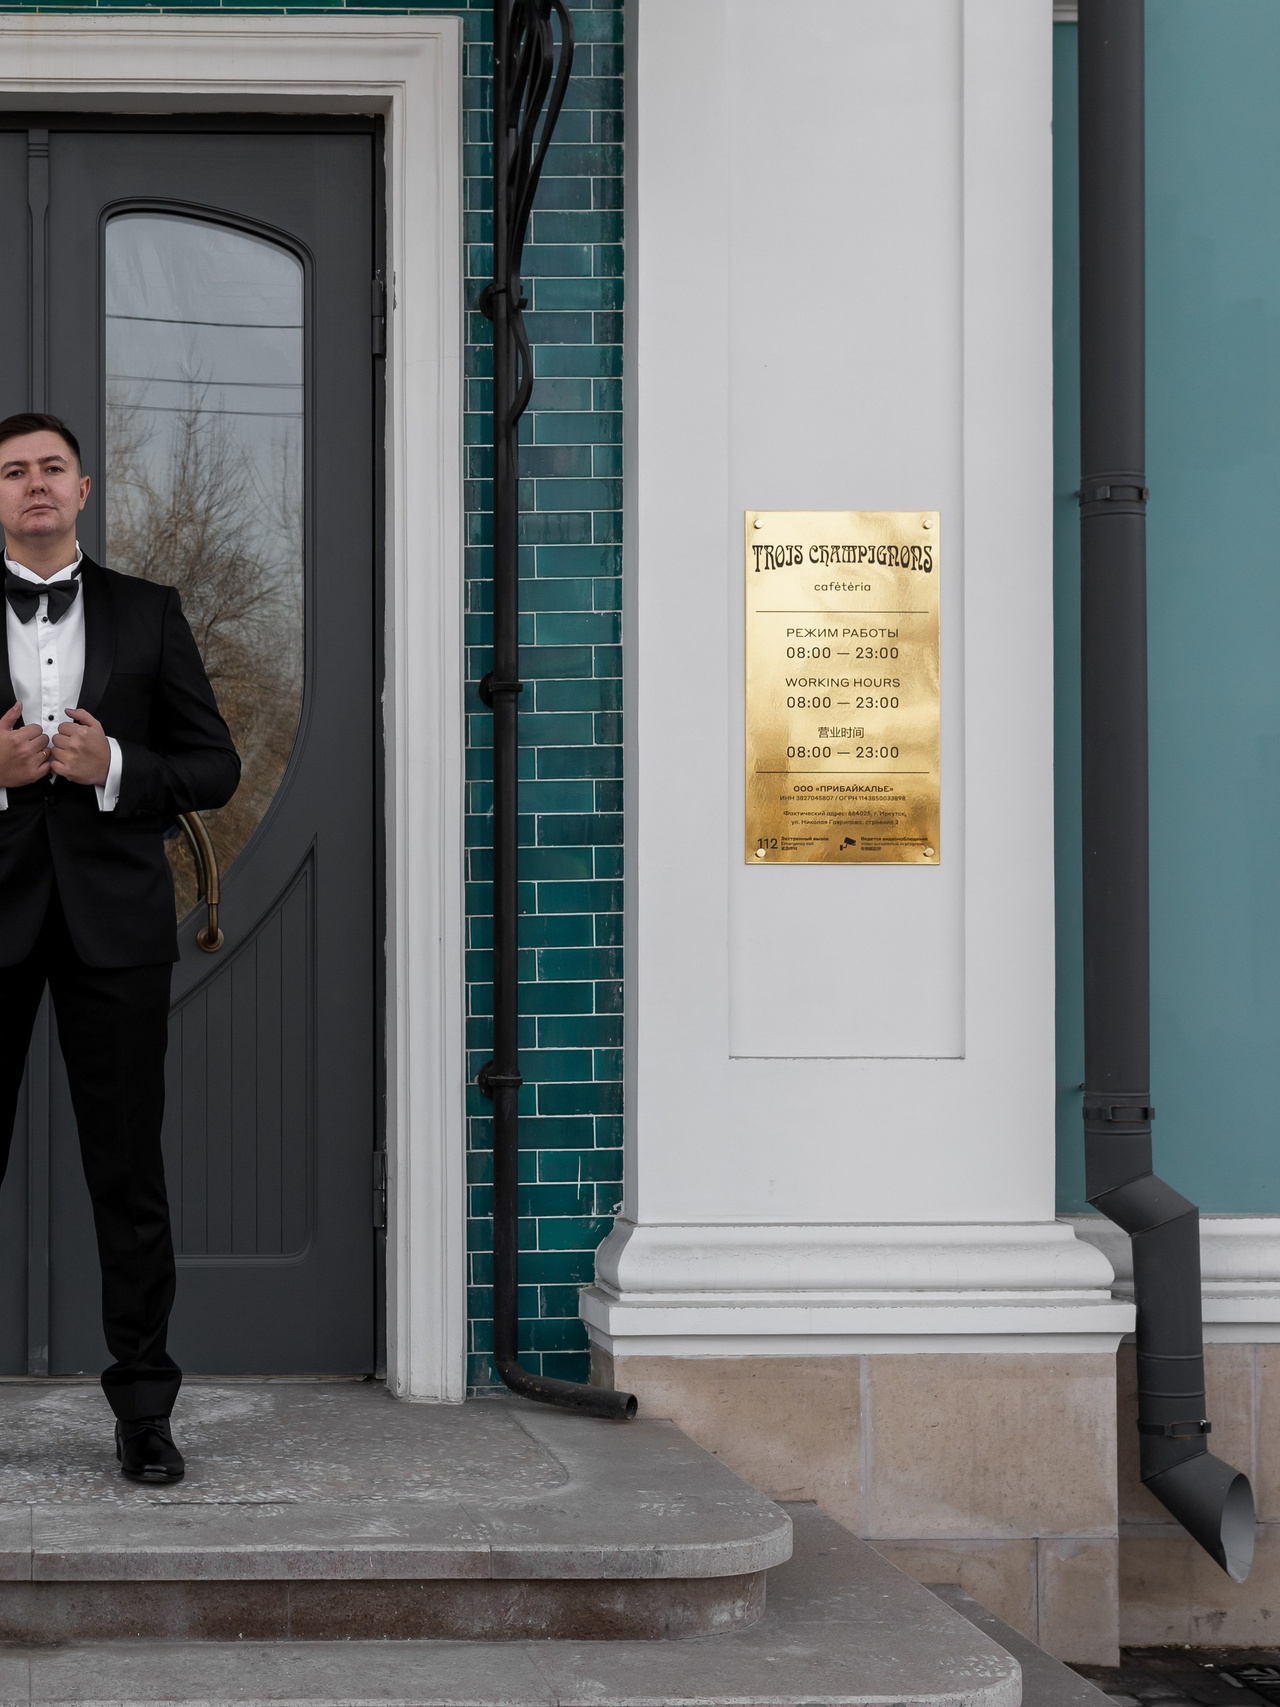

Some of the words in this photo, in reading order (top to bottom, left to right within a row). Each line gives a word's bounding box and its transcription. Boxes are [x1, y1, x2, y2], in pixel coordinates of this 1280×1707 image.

[752, 545, 803, 572] TROIS
[814, 582, 871, 591] cafétéria
[787, 628, 838, 638] РЕЖИМ
[842, 628, 898, 638] РАБОТЫ
[786, 647, 831, 659] 08:00
[856, 647, 899, 659] 23:00
[785, 678, 850, 688] WORKING
[853, 678, 900, 688] HOURS
[787, 696, 831, 708] 08:00
[856, 696, 899, 709] 23:00
[818, 726, 864, 739] 营业时间
[787, 746, 831, 758] 08:00
[856, 746, 899, 758] 23:00
[815, 784, 894, 792] «ПРИБАЙКАЛЬЕ»
[757, 837, 778, 849] 112
